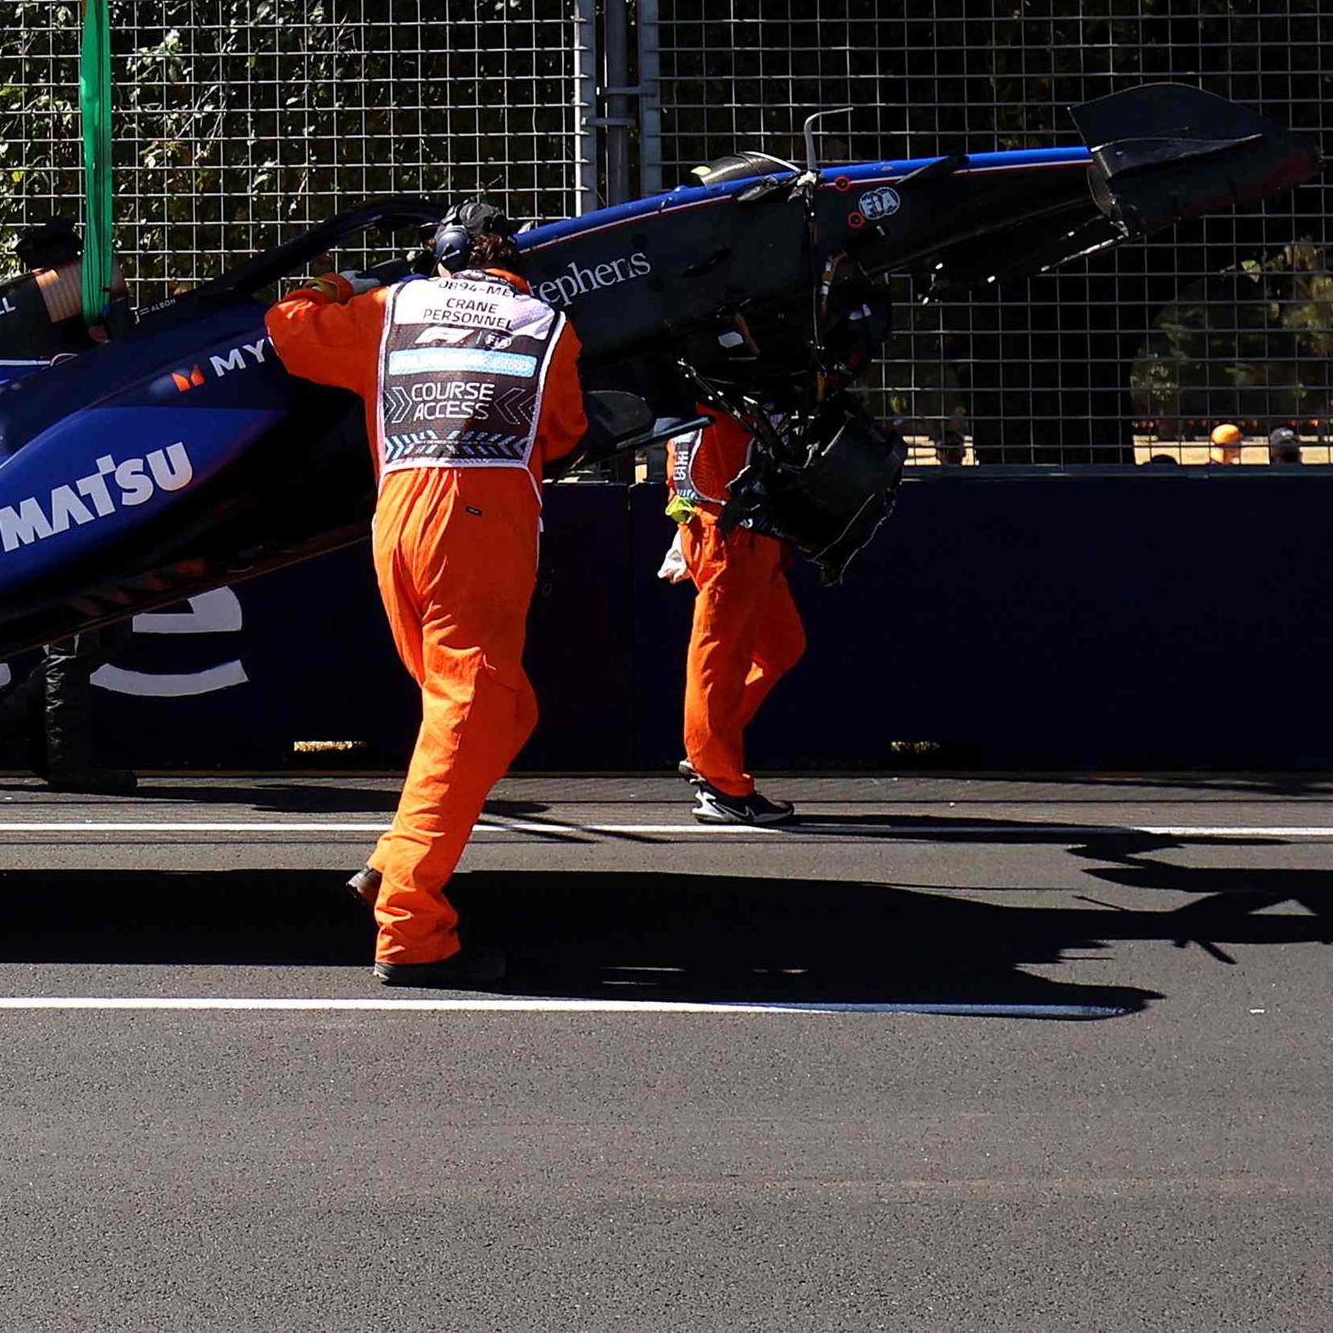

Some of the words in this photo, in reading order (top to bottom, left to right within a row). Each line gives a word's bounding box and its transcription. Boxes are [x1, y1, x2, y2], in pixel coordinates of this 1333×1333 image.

[861, 191, 898, 217] FIA
[439, 280, 516, 299] 0894-ME
[525, 251, 652, 308] tephens
[446, 297, 499, 315] CRANE
[423, 308, 513, 332] PERSONNEL
[209, 336, 274, 378] MY
[412, 381, 495, 401] COURSE
[413, 401, 490, 421] ACCESS
